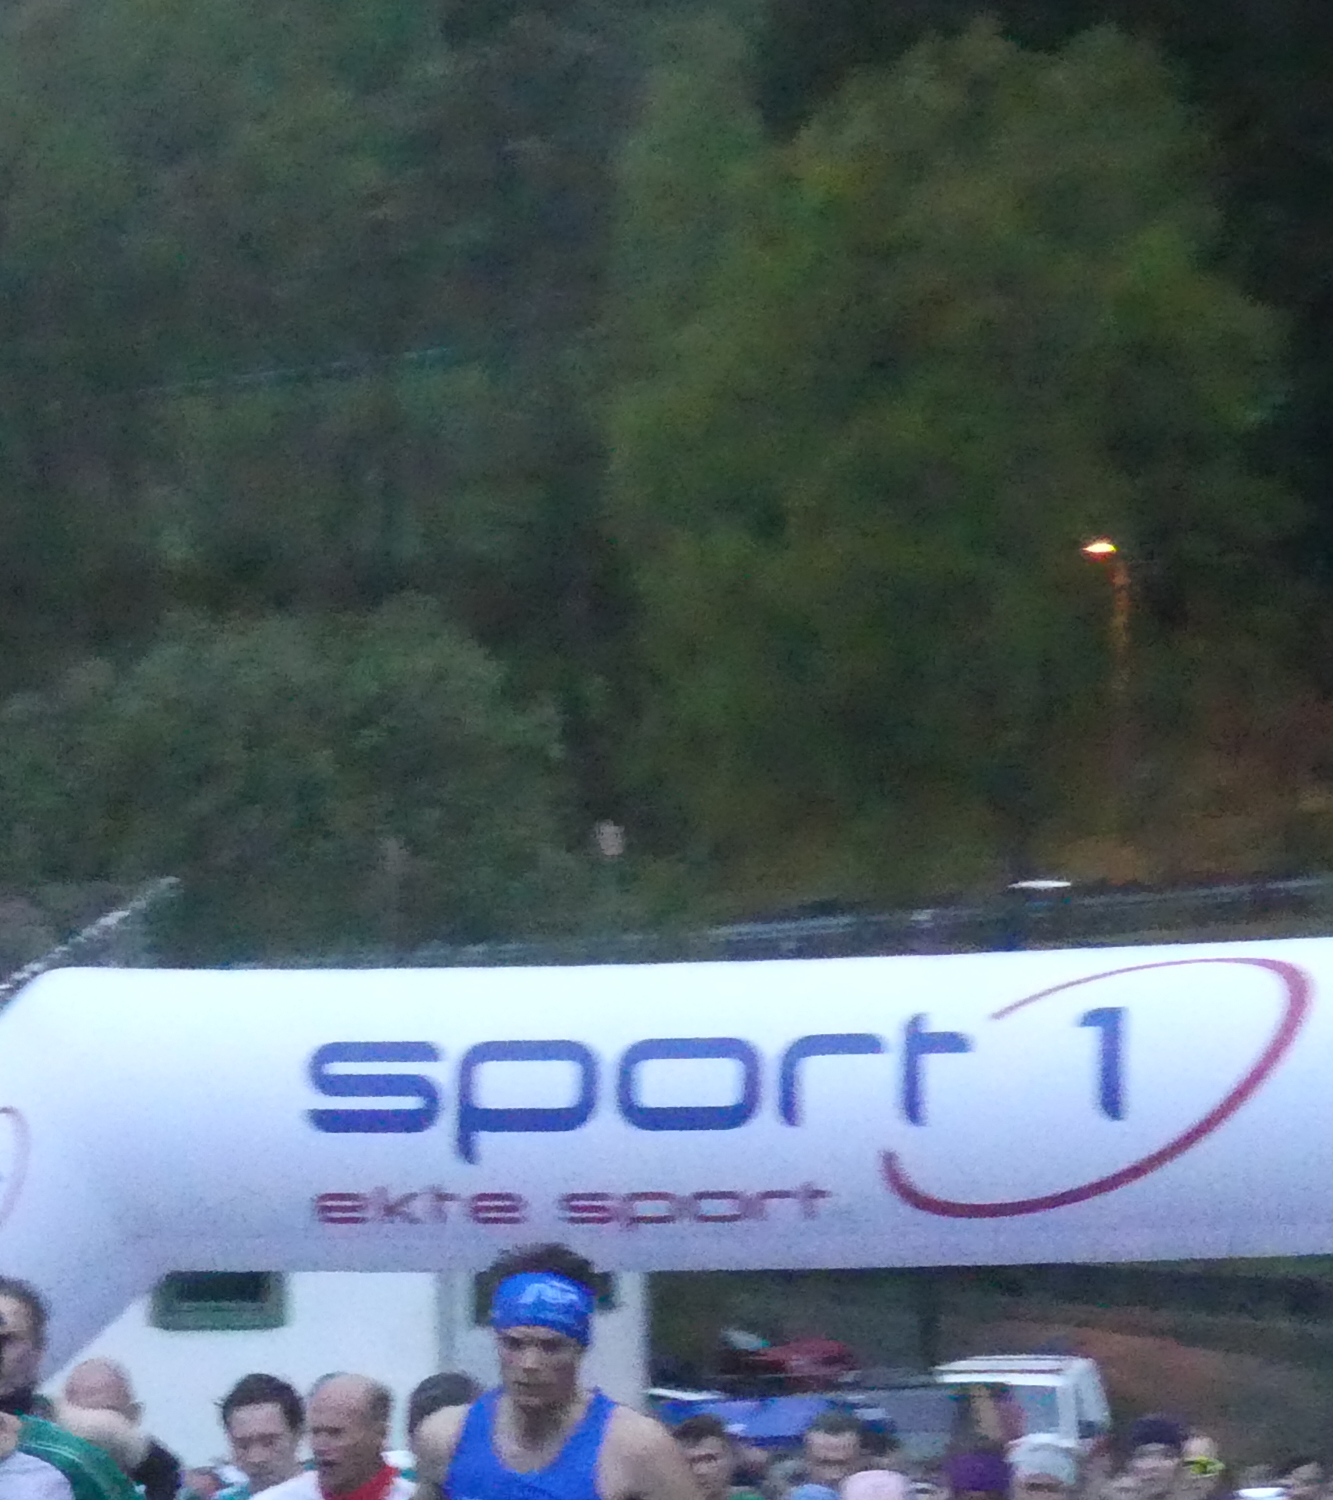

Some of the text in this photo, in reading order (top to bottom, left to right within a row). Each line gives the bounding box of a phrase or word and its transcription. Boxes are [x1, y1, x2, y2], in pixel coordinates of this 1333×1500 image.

[307, 1006, 1130, 1163] sport 1
[313, 1182, 835, 1231] ekte sport
